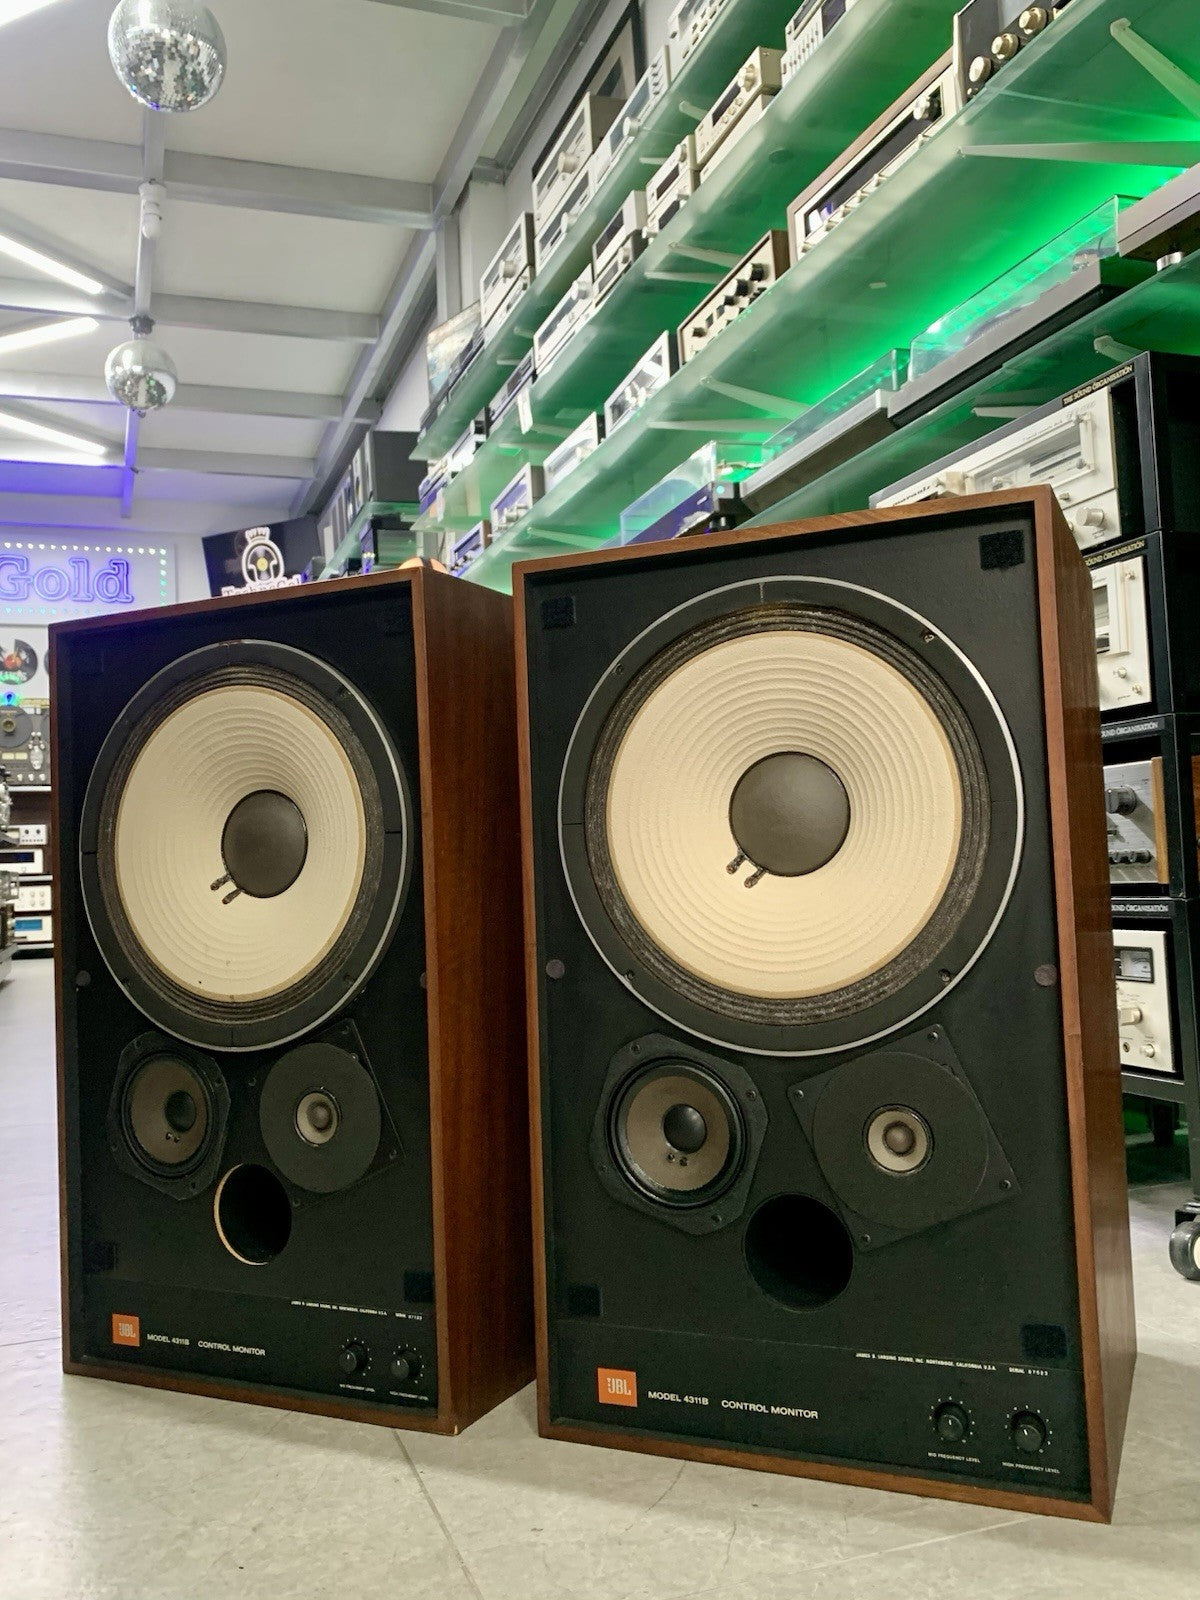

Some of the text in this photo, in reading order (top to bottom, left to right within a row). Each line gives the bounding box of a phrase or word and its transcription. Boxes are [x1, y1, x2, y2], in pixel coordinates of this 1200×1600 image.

[1073, 384, 1092, 401] SOUND
[0, 554, 135, 603] Gold
[118, 1322, 136, 1338] JBL
[147, 1333, 170, 1343] MODEL
[197, 1340, 231, 1352] CONTROL
[232, 1345, 266, 1356] MONITOR
[607, 1377, 632, 1396] JBL
[648, 1391, 819, 1419] MODEL 4311B CONTROL MONITOR
[938, 1453, 965, 1462] FREQUENCY
[1015, 1463, 1044, 1473] FREQUENCY
